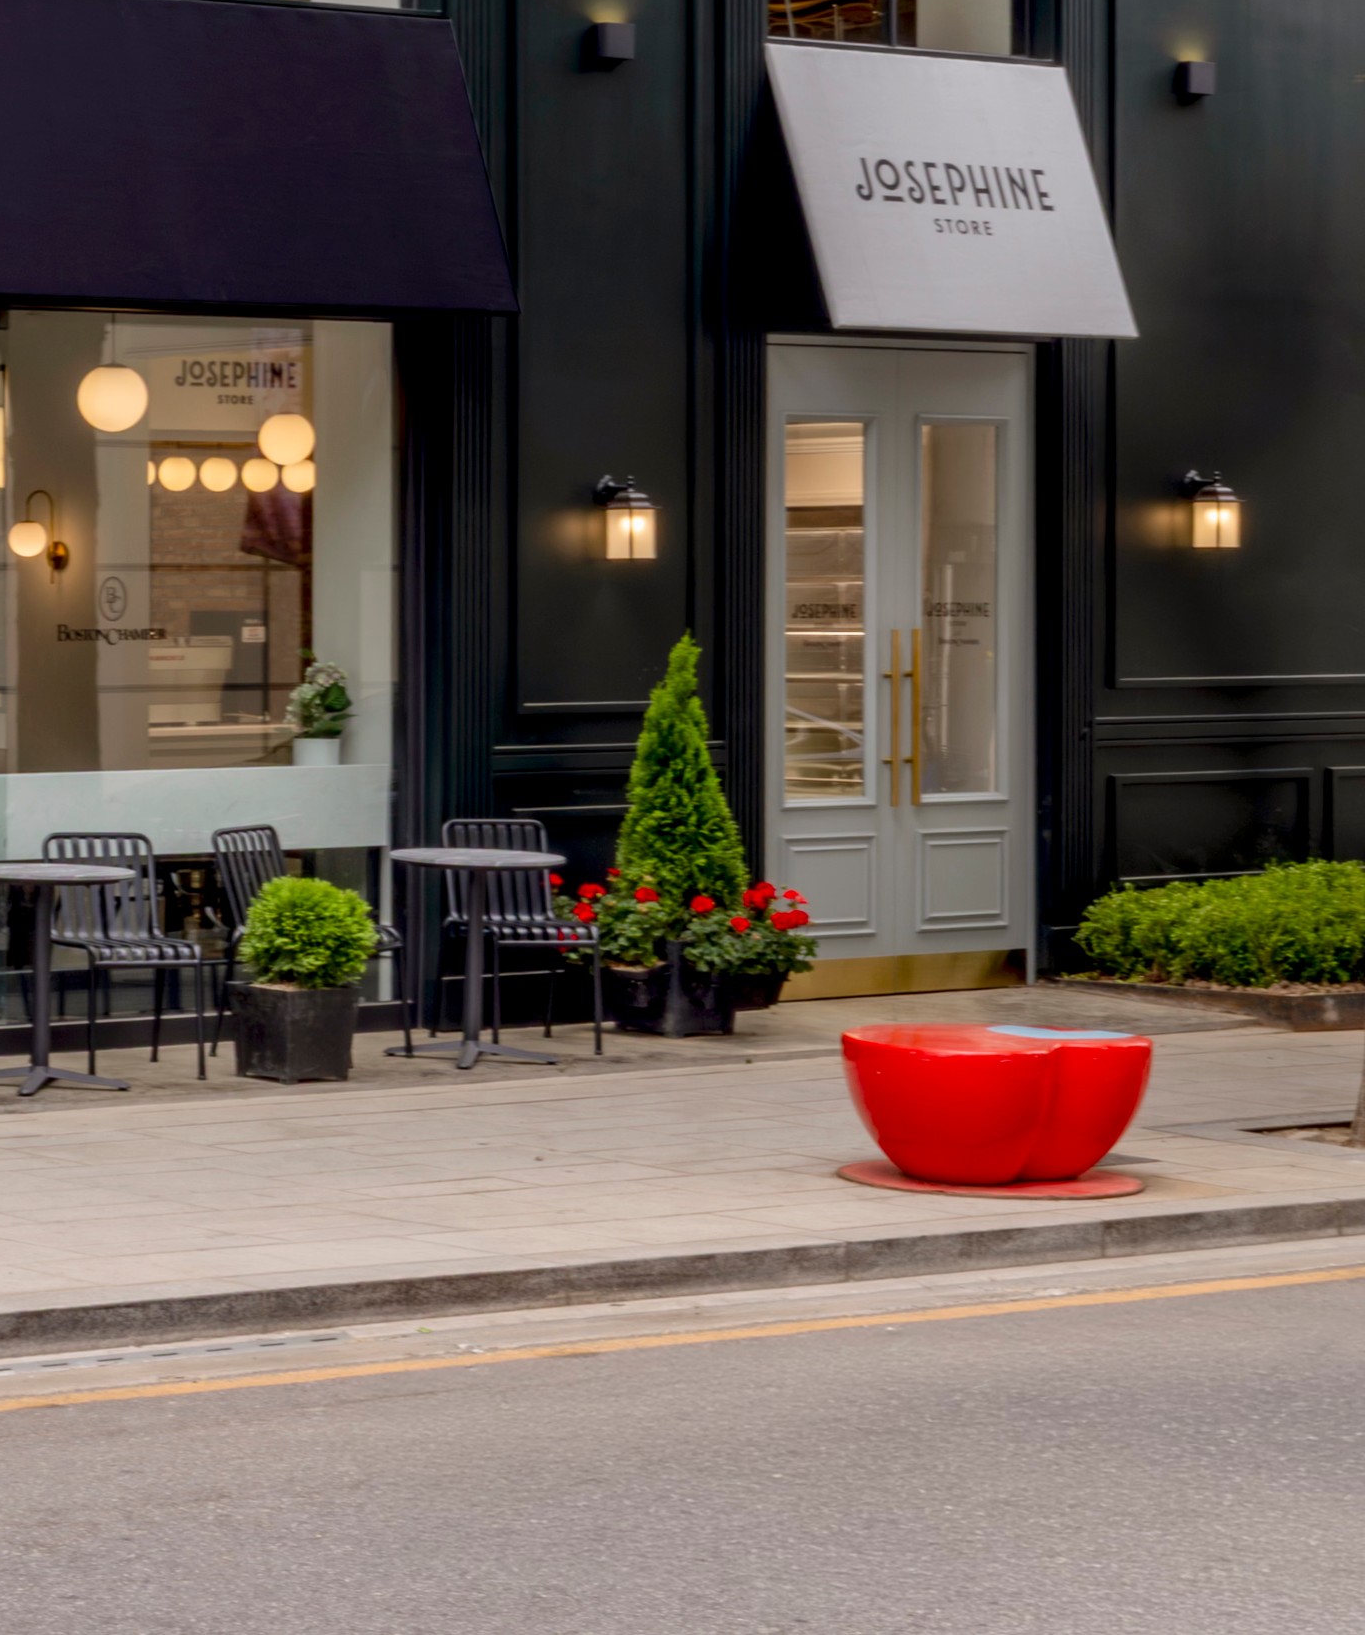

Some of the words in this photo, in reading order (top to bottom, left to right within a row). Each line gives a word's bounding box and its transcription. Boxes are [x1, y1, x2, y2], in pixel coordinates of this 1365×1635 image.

[856, 158, 1054, 211] JOSEPHINE
[934, 218, 993, 236] STORE
[175, 360, 297, 389] JOSEPHINE
[217, 395, 254, 405] STORE
